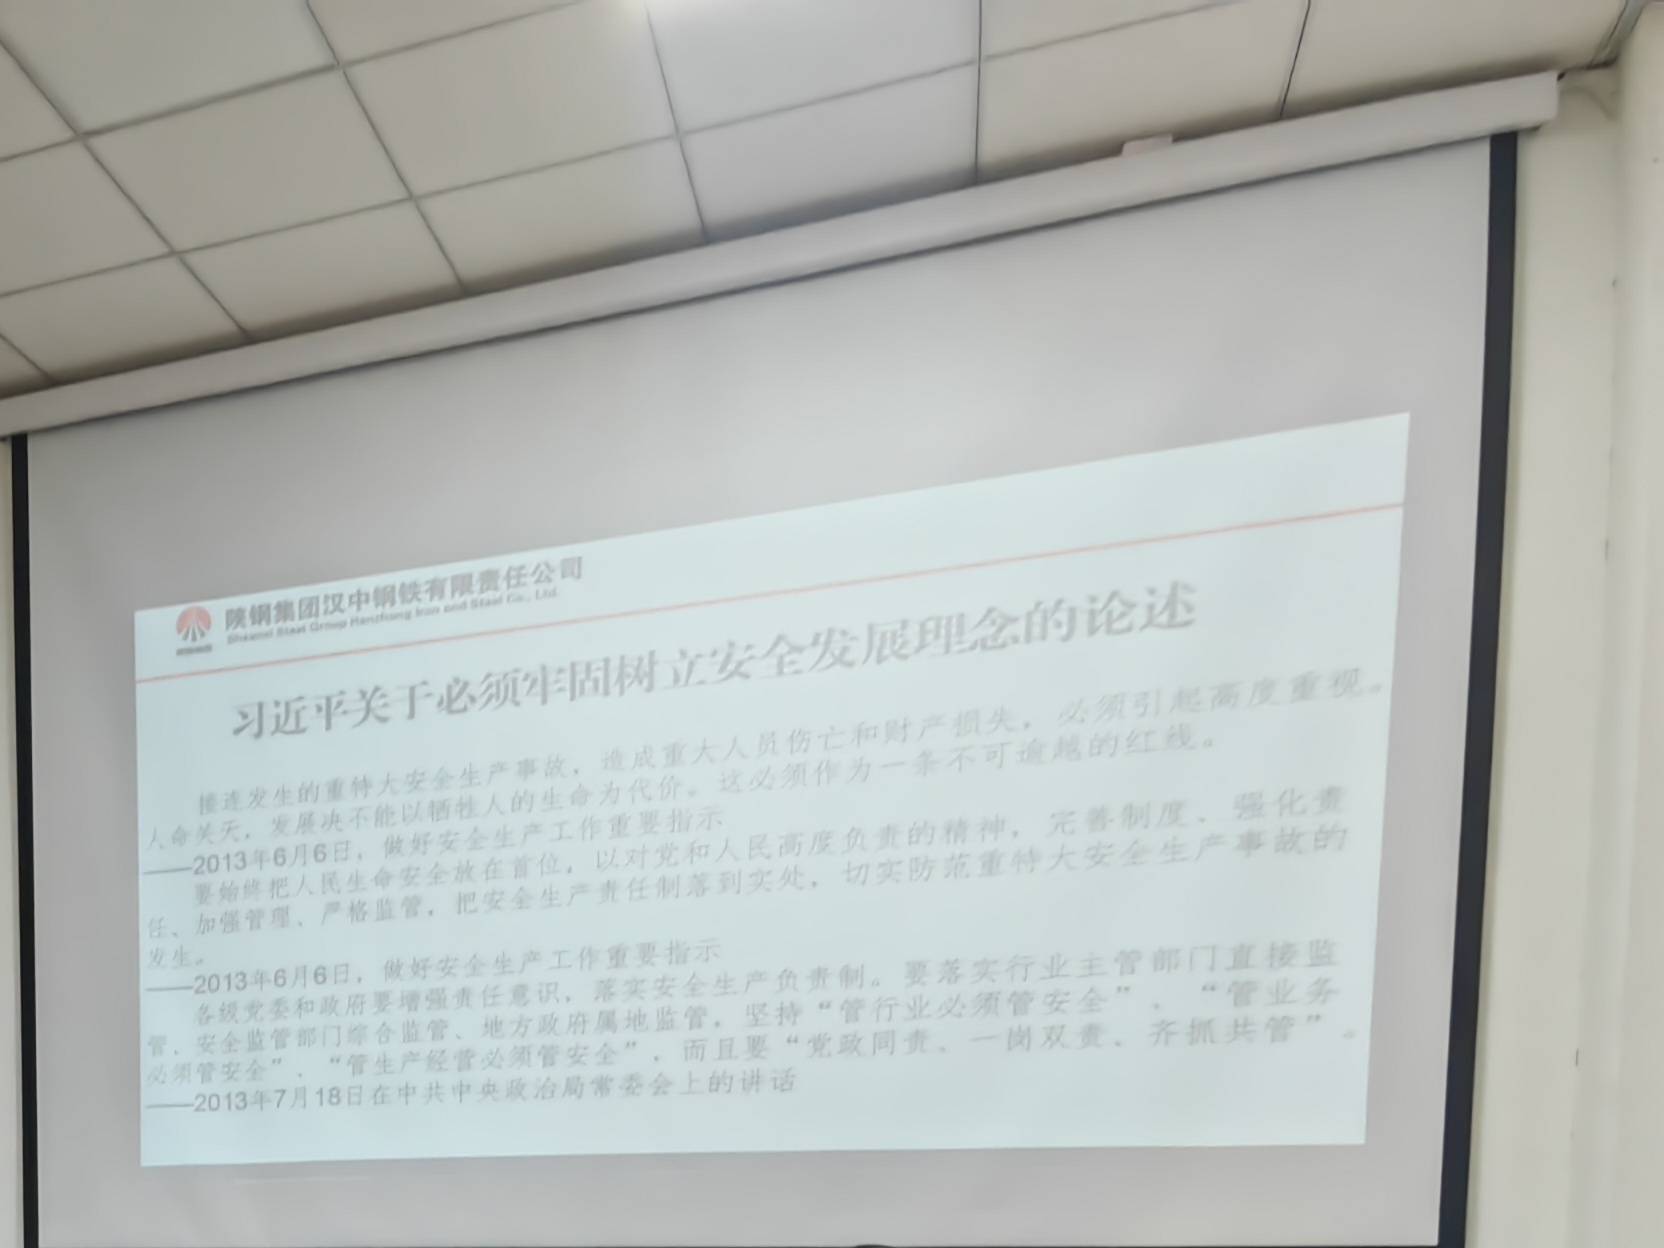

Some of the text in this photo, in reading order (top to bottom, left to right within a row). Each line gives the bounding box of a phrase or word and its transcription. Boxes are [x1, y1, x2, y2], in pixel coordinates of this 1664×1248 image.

[225, 555, 584, 632] 陕钢集团汉中钢铁有限责任公司
[232, 580, 1197, 741] 习近平关于必须牢固树立安全发展理念的论述
